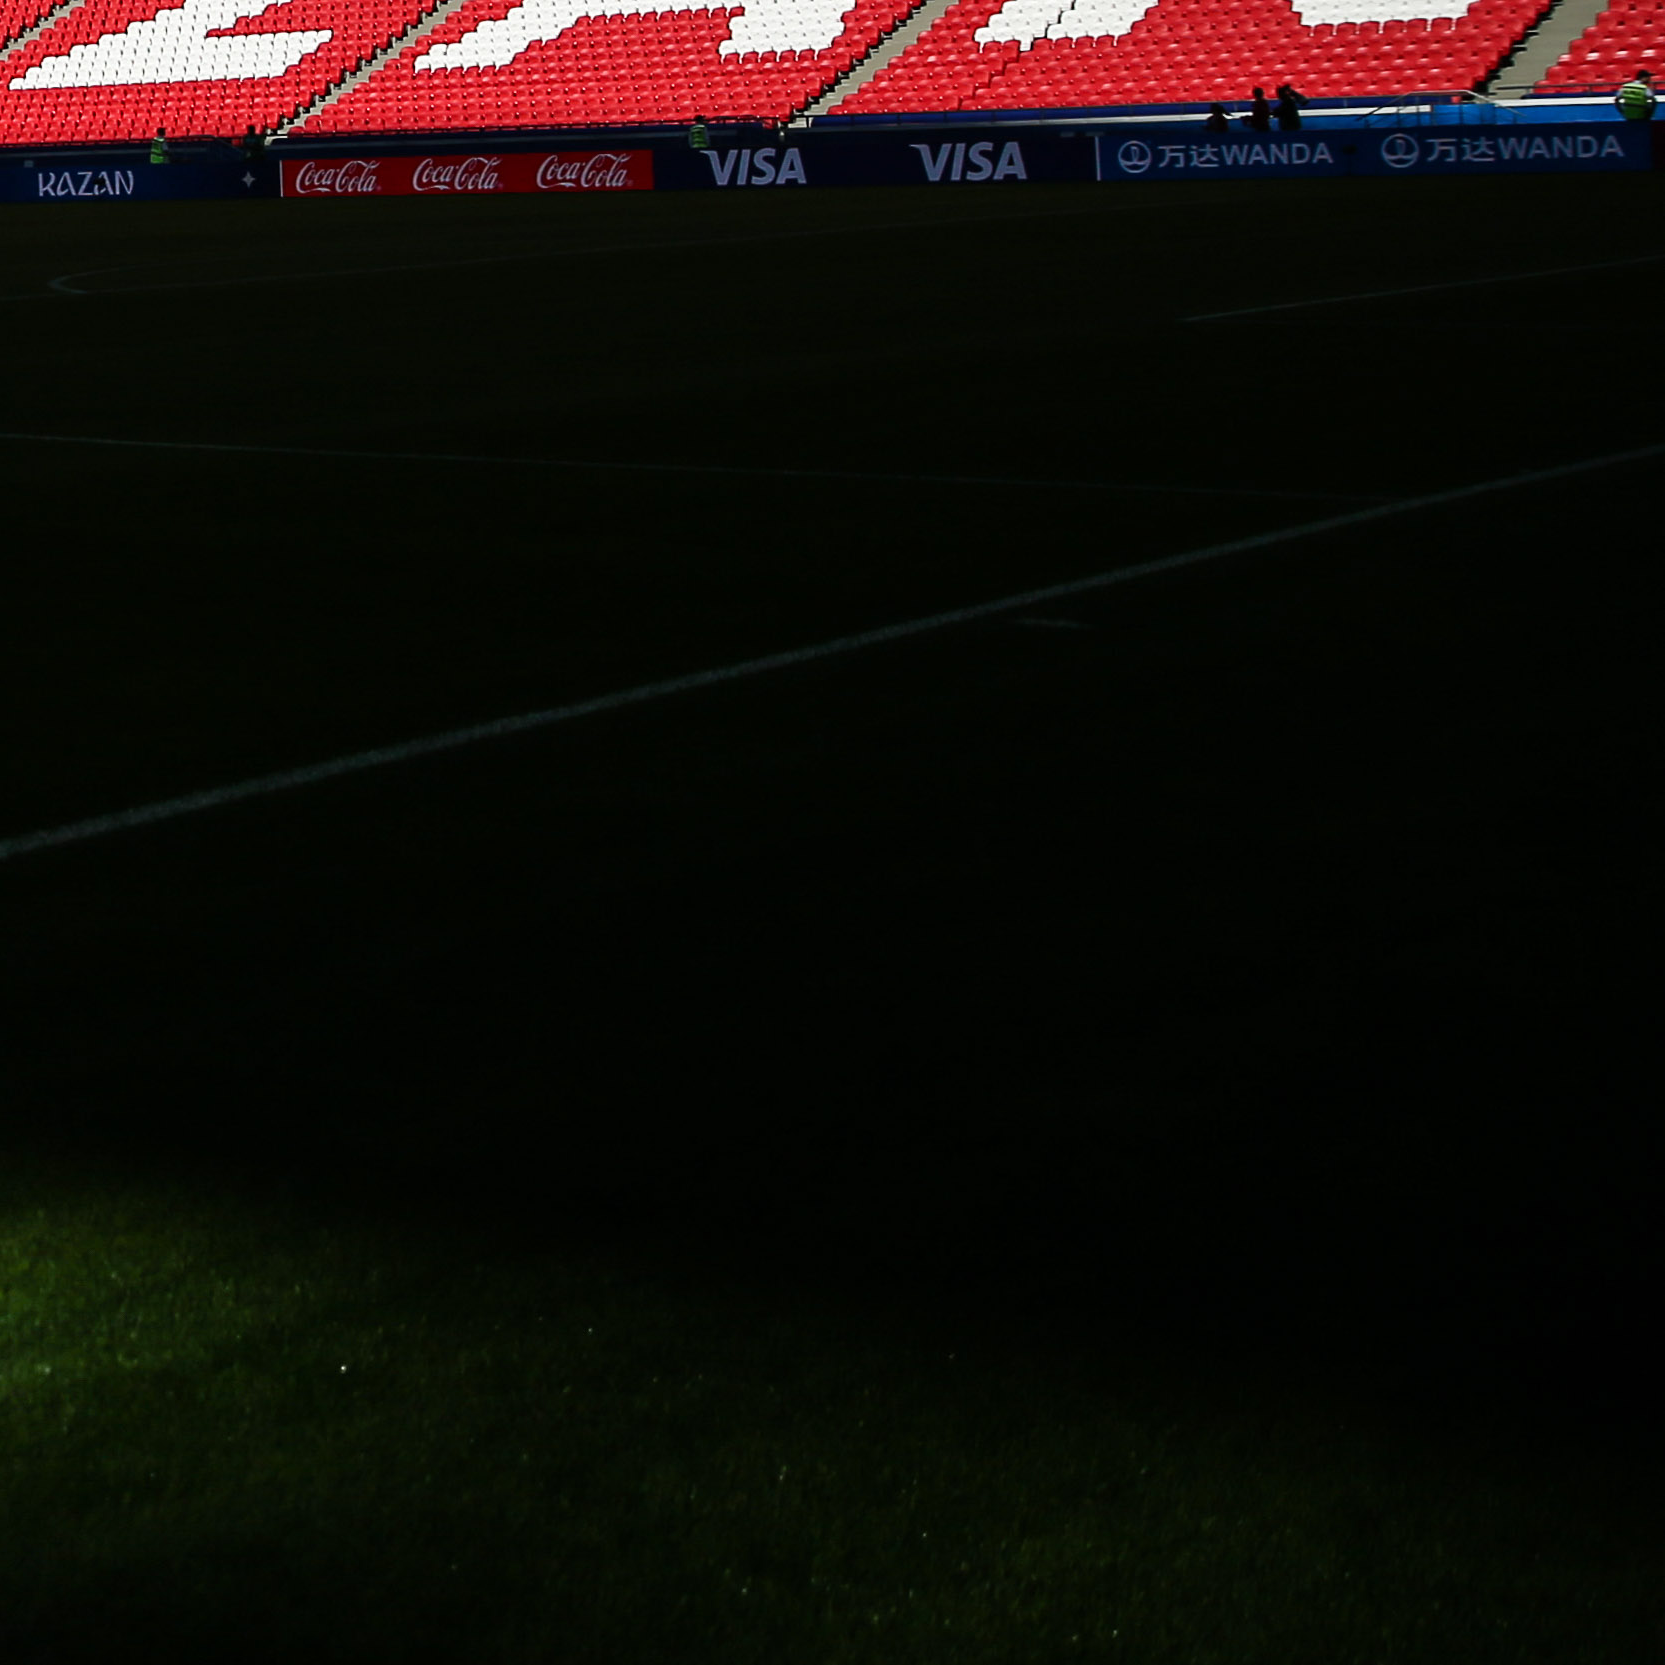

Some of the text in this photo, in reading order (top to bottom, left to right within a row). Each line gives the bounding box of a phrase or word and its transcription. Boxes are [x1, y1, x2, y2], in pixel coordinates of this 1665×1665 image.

[700, 141, 1028, 187] VISA VISA
[37, 170, 135, 199] KAZAN
